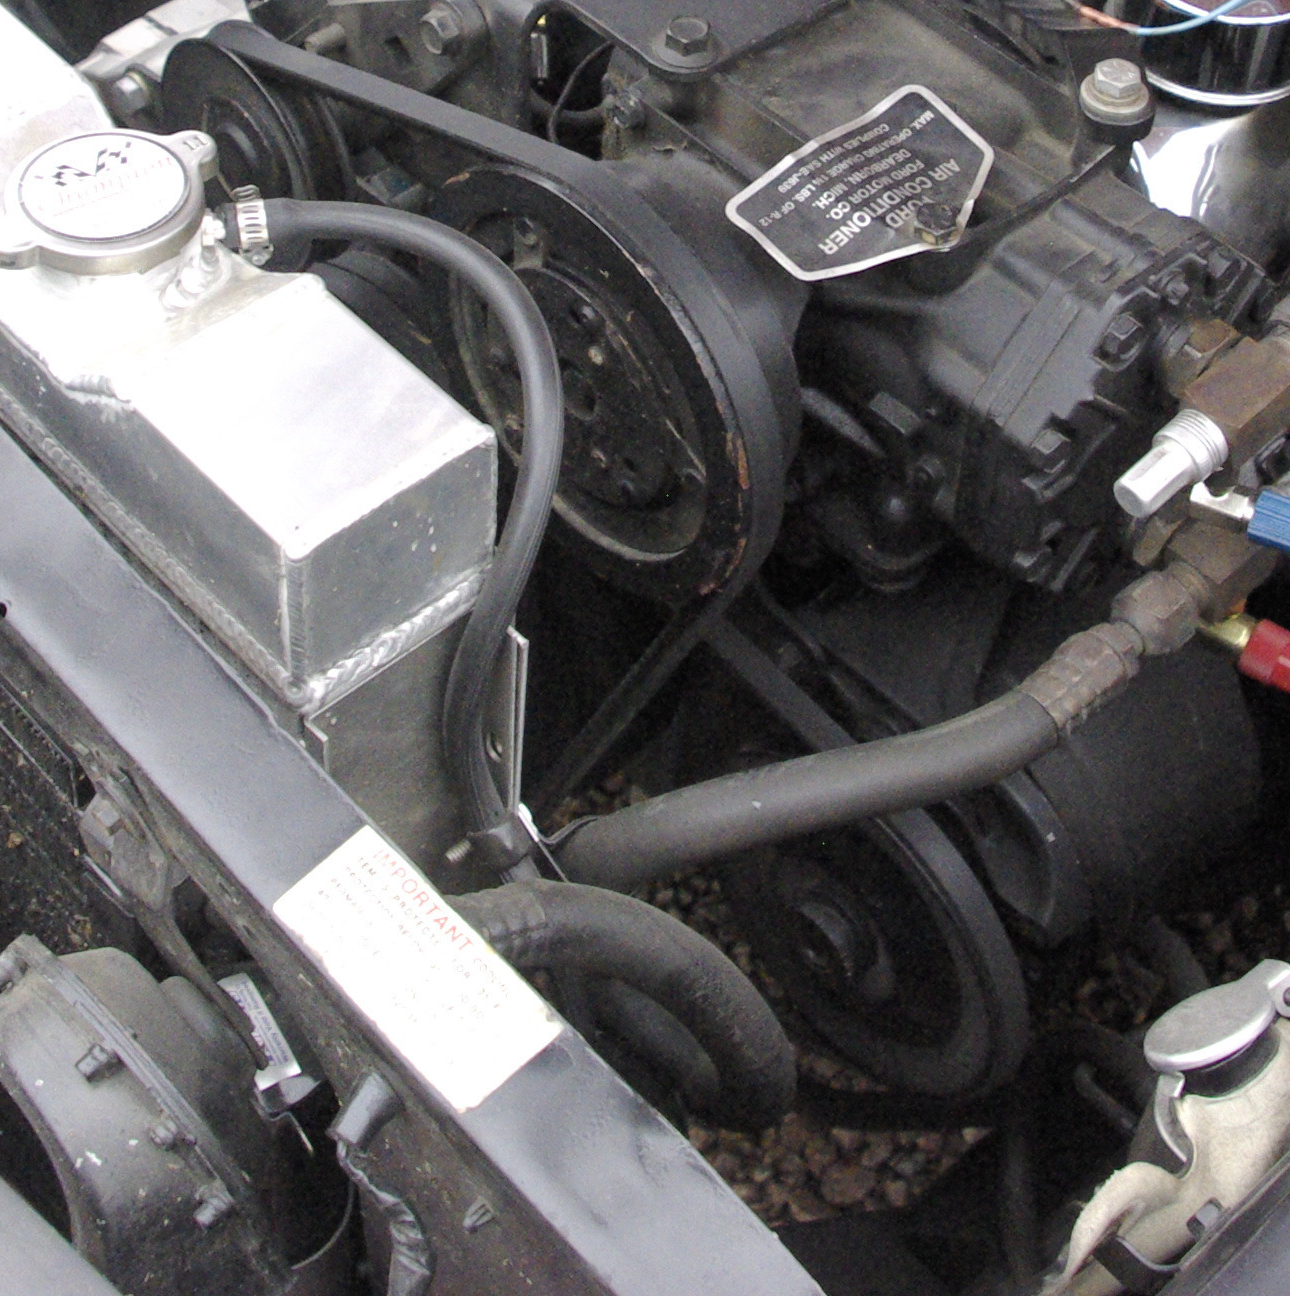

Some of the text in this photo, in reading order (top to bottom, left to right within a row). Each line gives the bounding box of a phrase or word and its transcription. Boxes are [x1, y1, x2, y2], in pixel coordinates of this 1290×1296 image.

[907, 109, 934, 129] MAX.
[817, 143, 846, 163] WITH
[810, 148, 911, 211] DEARBORN, MICH.
[824, 157, 925, 222] FORD MOTOR CO.
[791, 181, 815, 202] LBS.
[779, 199, 795, 215] OF
[817, 157, 960, 256] AIR CONDITIONER
[758, 209, 782, 227] R-12
[372, 847, 474, 951] IMPORTANT
